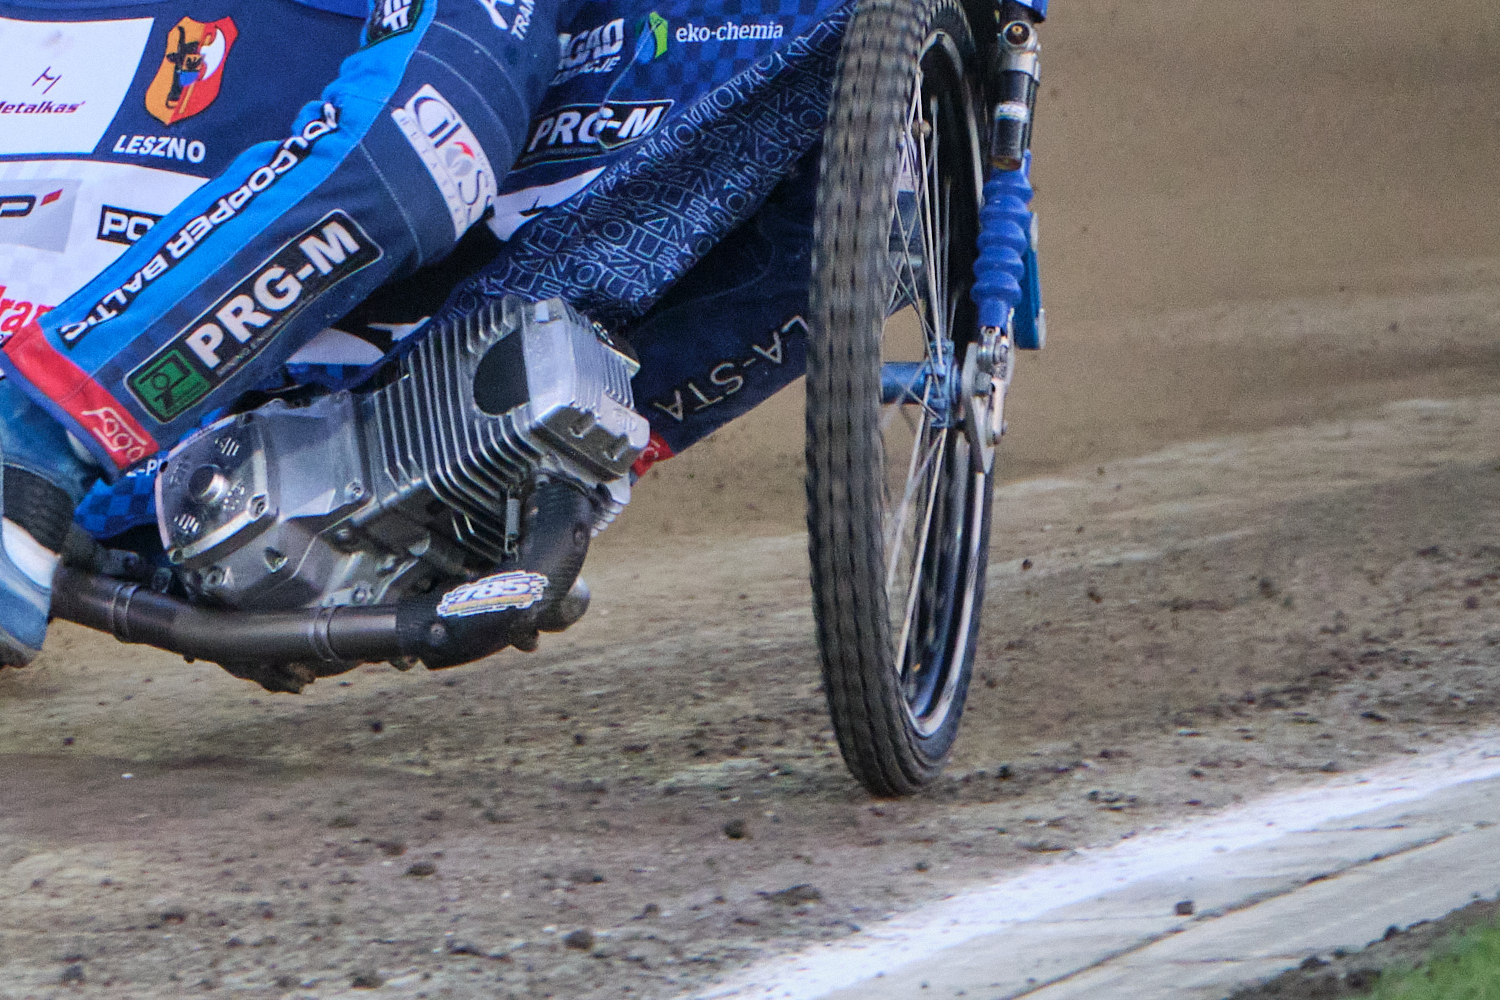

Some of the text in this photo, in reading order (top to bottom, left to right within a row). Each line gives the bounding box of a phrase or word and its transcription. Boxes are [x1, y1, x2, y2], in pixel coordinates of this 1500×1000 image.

[676, 21, 784, 42] eko-chemia
[112, 134, 206, 164] LESZNO
[528, 107, 665, 152] PRG-M
[60, 254, 170, 341] BALTIC
[185, 221, 360, 369] PRG-M
